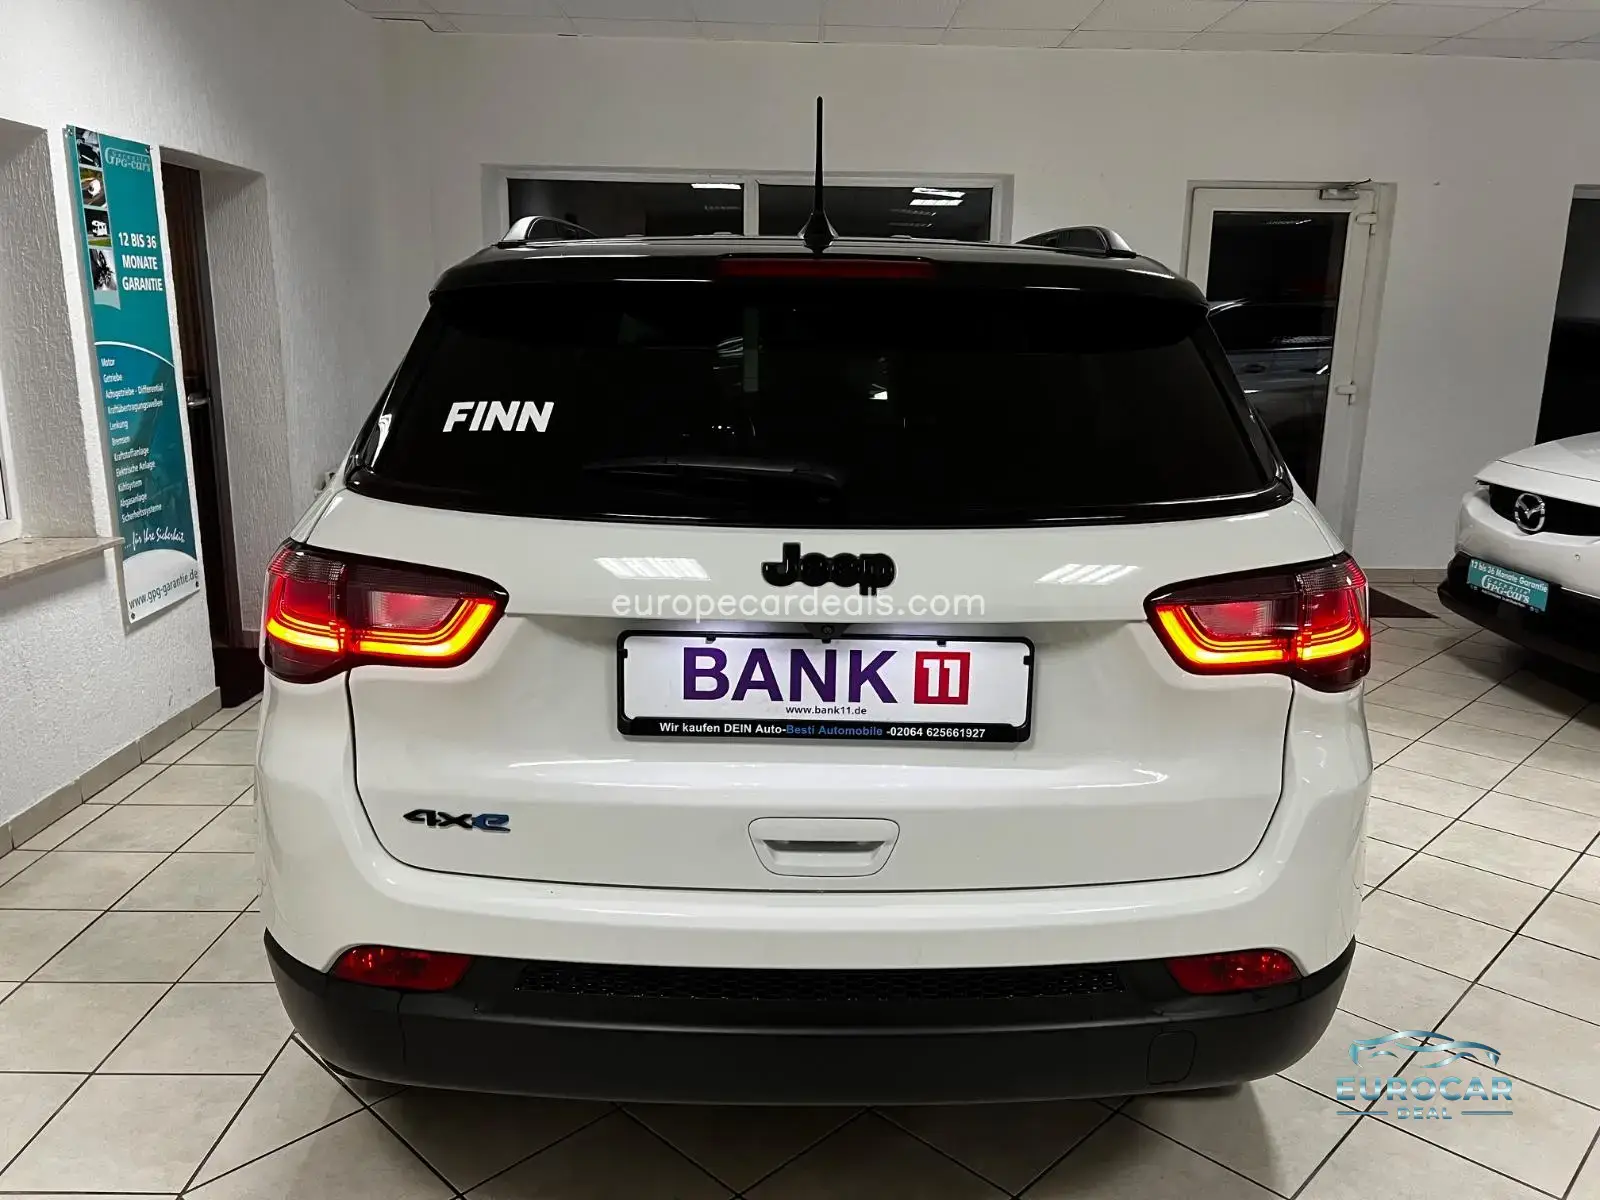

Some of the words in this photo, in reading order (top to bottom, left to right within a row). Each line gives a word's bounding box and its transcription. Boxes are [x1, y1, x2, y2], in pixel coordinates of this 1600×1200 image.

[119, 231, 129, 246] 12
[131, 233, 145, 248] BIS
[147, 234, 157, 248] 36
[121, 254, 158, 270] MONATE
[122, 276, 163, 291] GARANTIE
[101, 358, 115, 367] Motor
[103, 372, 122, 383] Getriebe
[442, 400, 555, 433] FINN
[761, 542, 898, 596] Jeep
[129, 569, 199, 609] www.gpg-garantie.de
[1520, 577, 1548, 593] Garantie
[683, 646, 898, 704] BANK
[922, 658, 963, 698] 11
[785, 704, 868, 717] www.bank11.de
[659, 721, 679, 733] Wir
[682, 722, 721, 734] kaufen
[724, 723, 752, 735] DEIN
[818, 724, 883, 737] Automobile
[926, 727, 986, 739] 625661927
